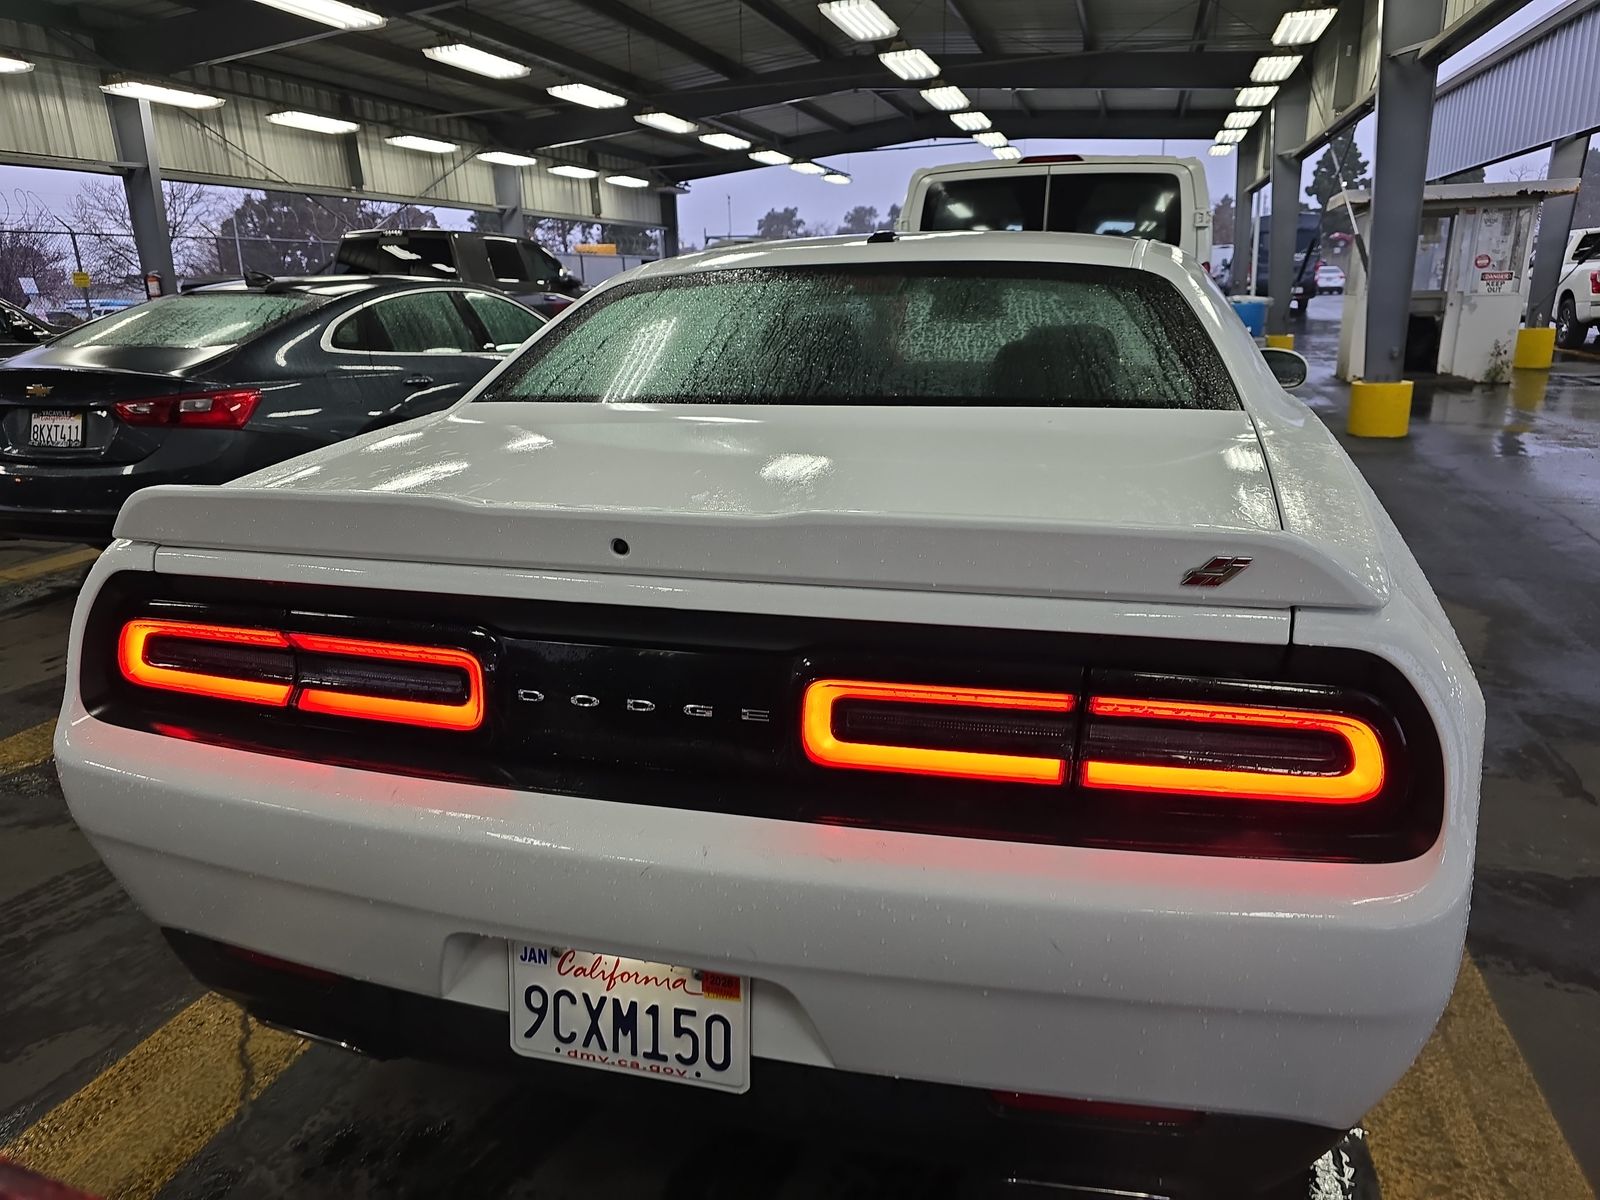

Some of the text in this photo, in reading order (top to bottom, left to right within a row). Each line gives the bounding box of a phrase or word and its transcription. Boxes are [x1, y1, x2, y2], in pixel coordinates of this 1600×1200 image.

[32, 424, 79, 441] 8KXT411
[518, 689, 769, 722] DODGE
[520, 946, 548, 965] JAN
[557, 949, 703, 995] California
[524, 985, 731, 1072] 9CXM150
[567, 1050, 687, 1078] dmv.ca.gov
